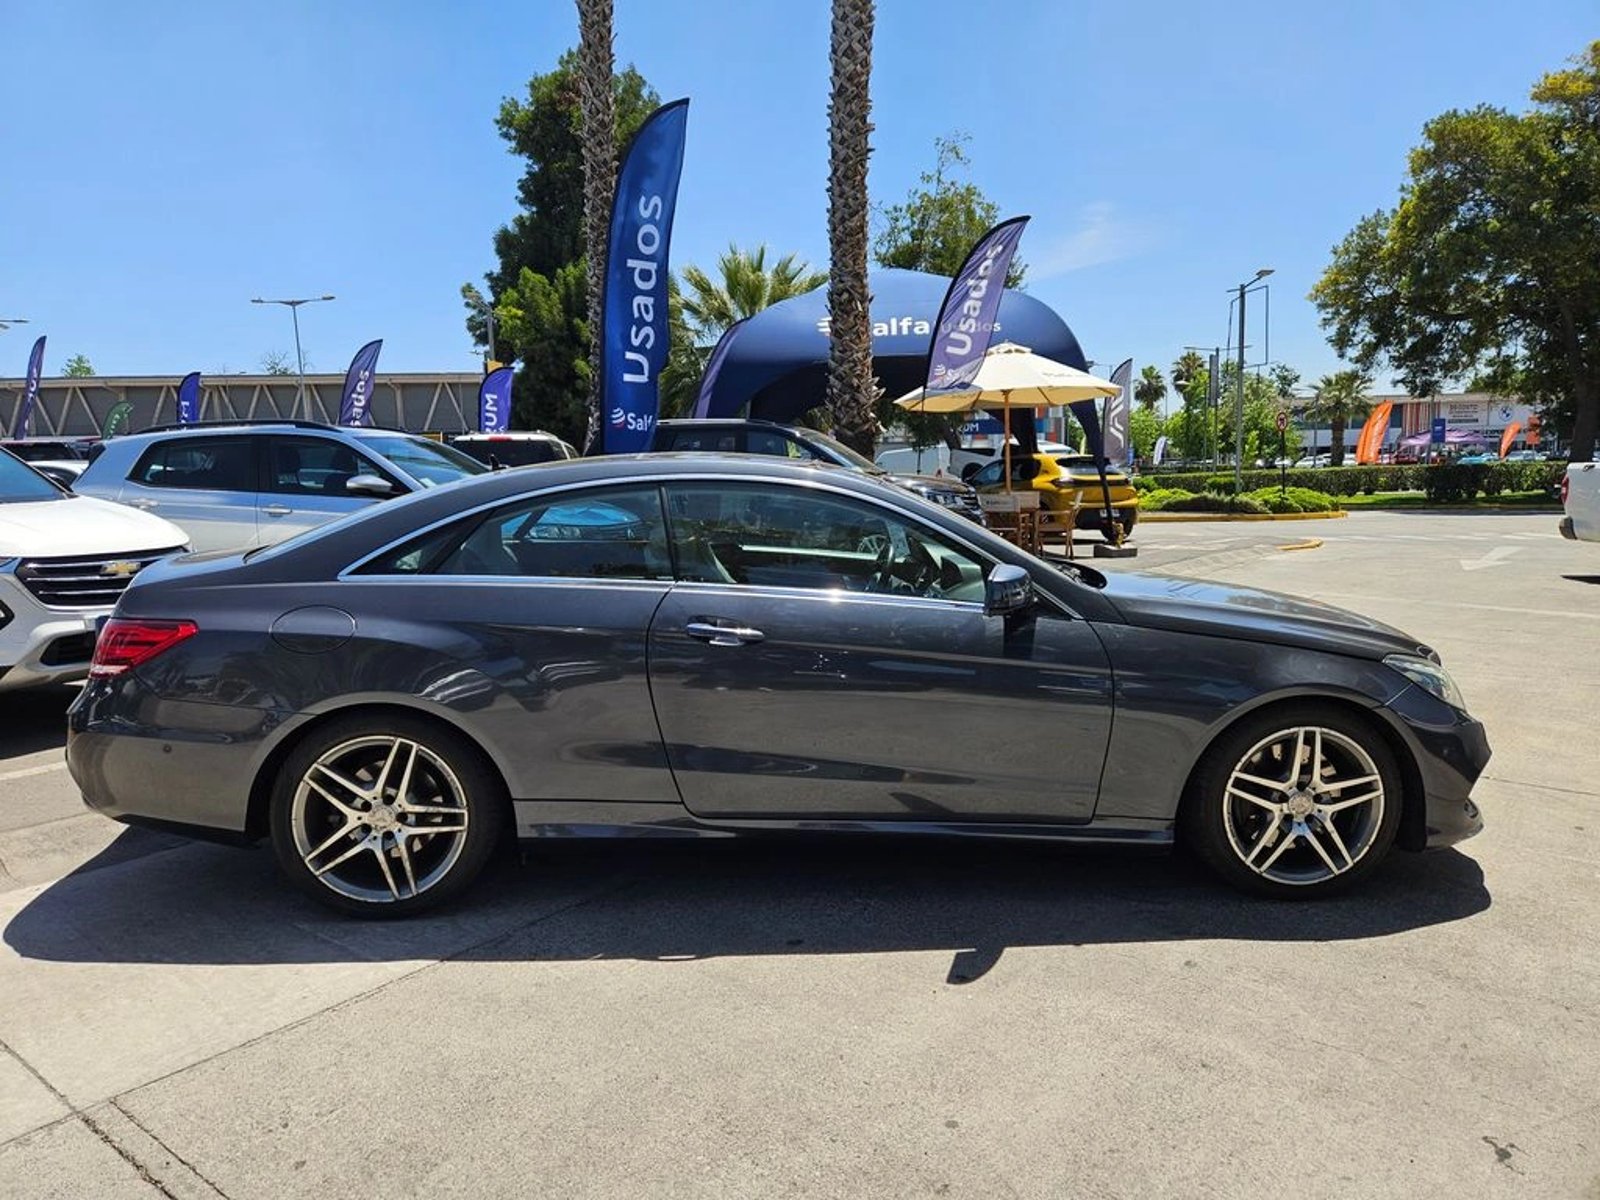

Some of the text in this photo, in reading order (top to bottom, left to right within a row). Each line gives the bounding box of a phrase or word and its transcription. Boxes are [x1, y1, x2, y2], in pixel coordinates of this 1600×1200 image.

[623, 194, 662, 383] Usados
[872, 317, 931, 337] alfa
[946, 244, 1003, 356] Usados
[349, 370, 370, 427] sados
